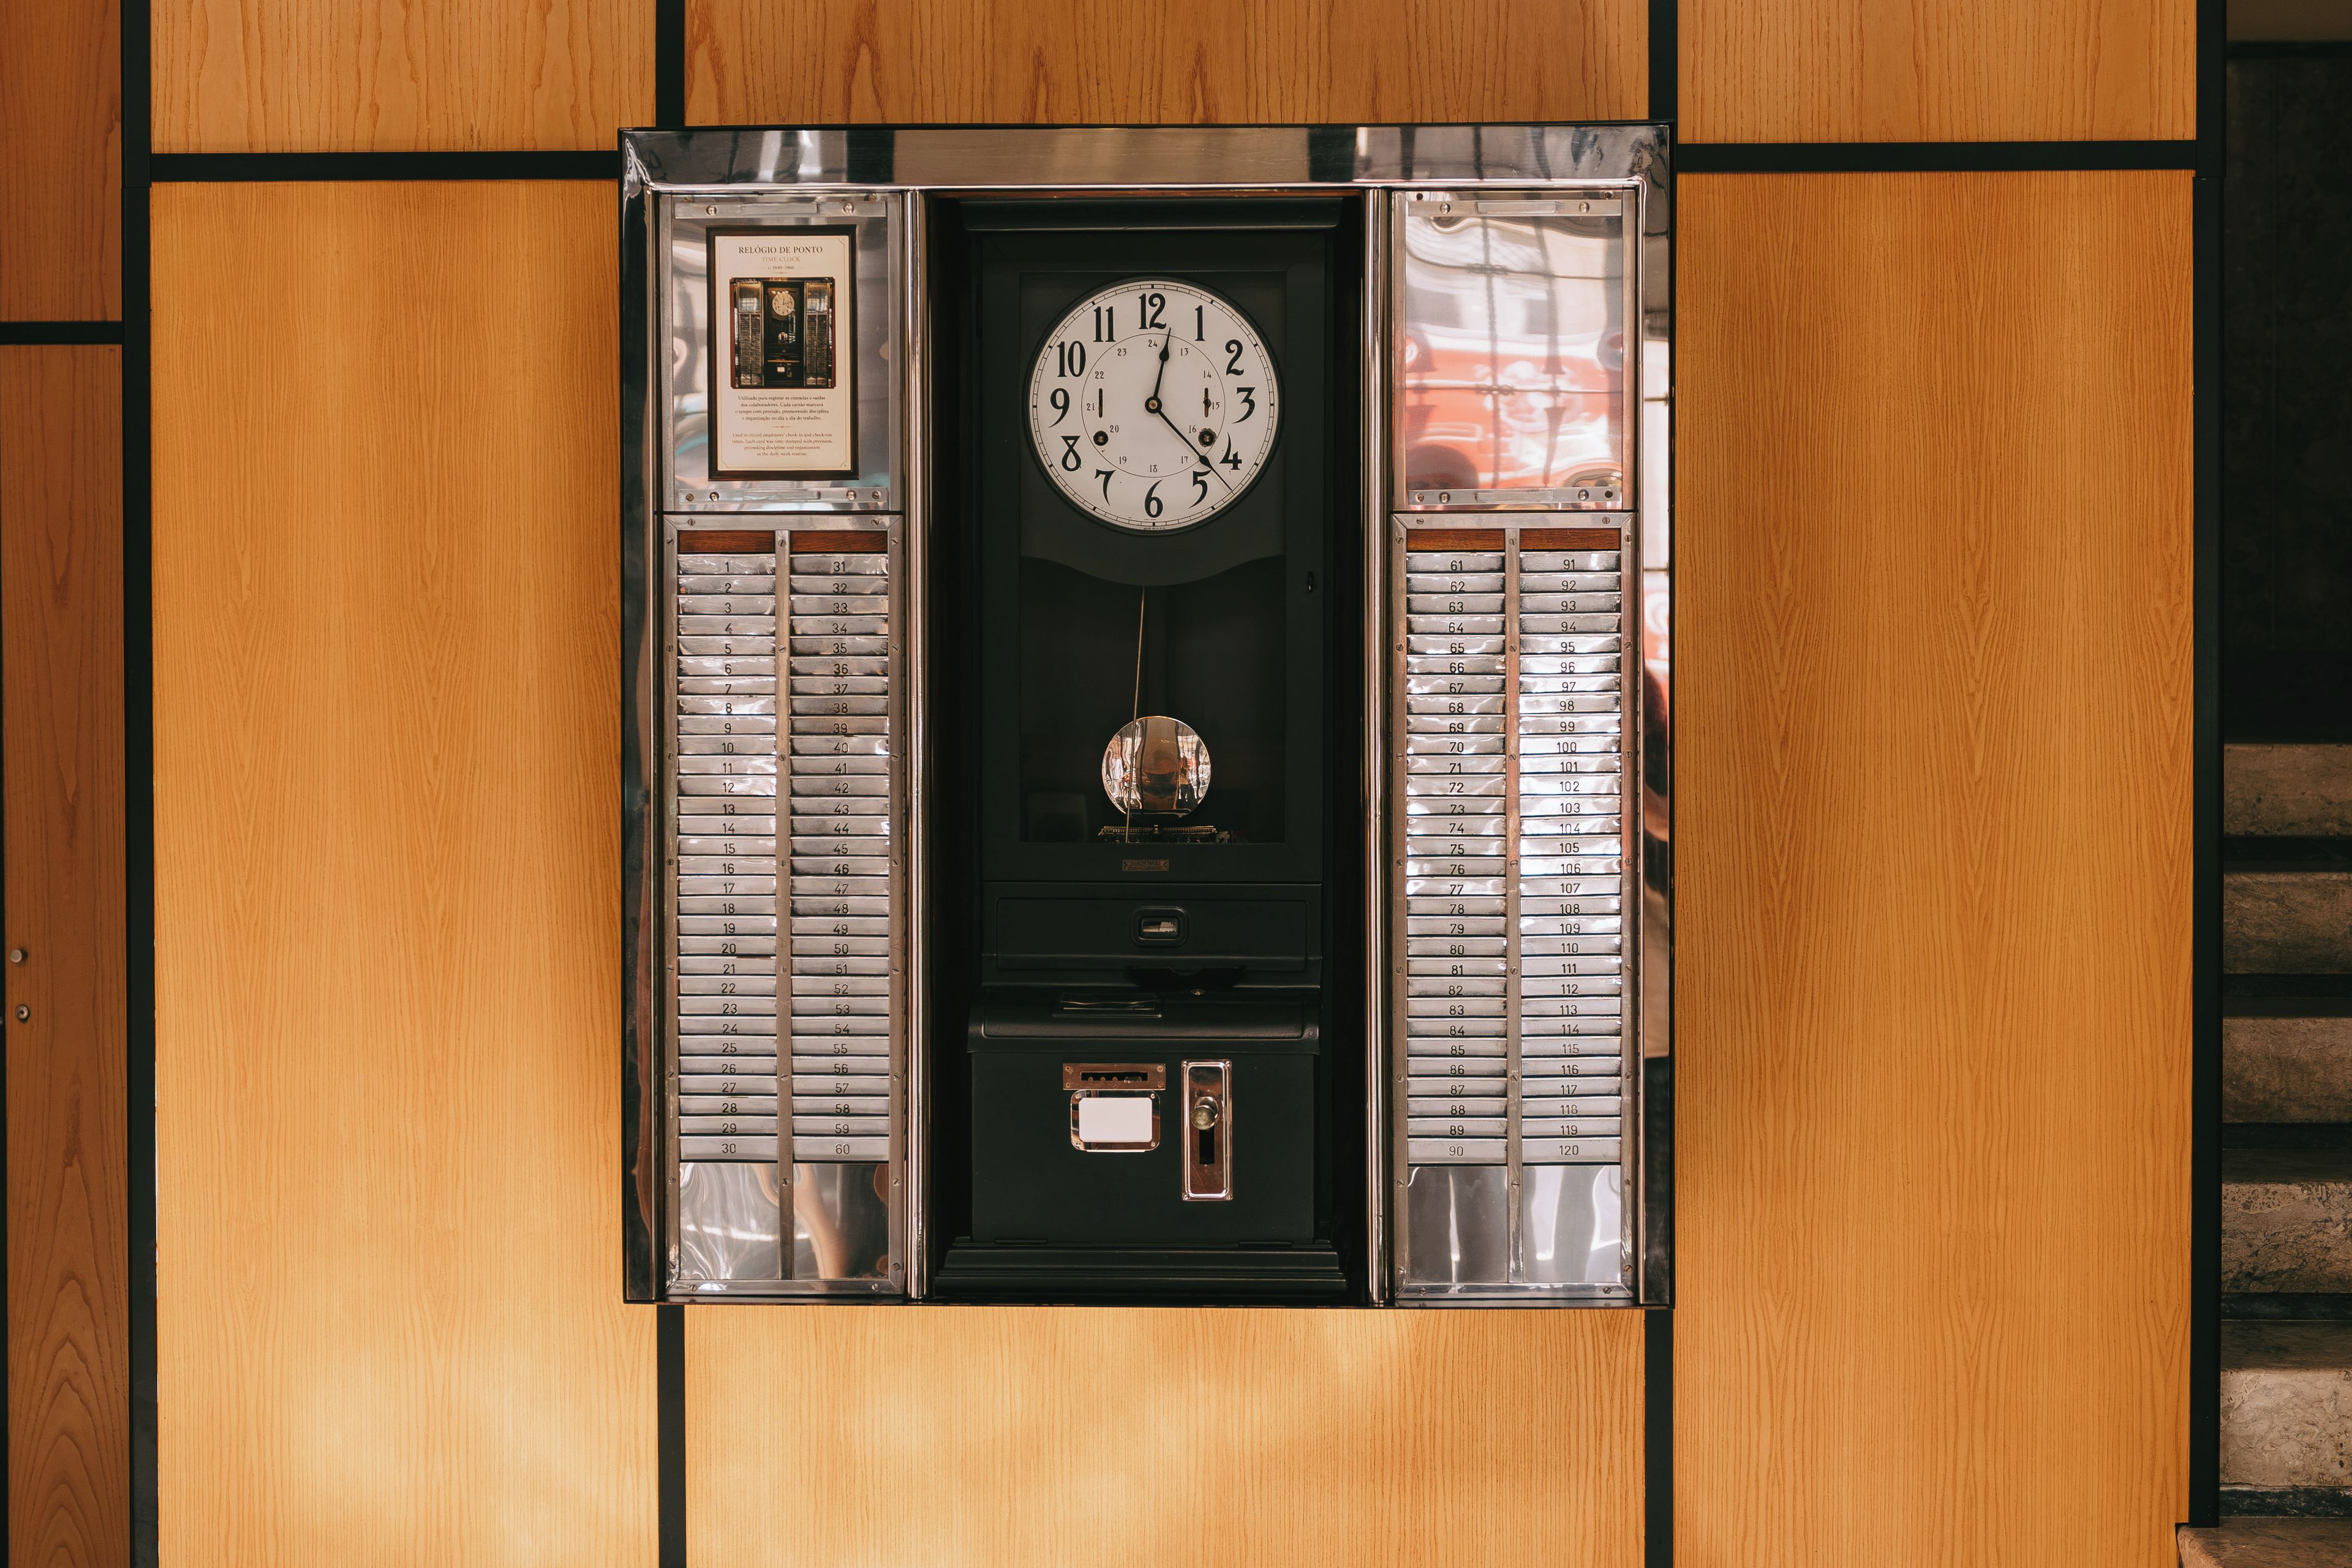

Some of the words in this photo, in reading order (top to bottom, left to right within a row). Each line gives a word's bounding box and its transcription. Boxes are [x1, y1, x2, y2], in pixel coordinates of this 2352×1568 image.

[739, 245, 777, 254] RELÓGIO
[1139, 293, 1166, 330] 12
[1093, 306, 1116, 342] 11
[1195, 305, 1205, 341] 1
[1057, 341, 1086, 377] 10
[1225, 339, 1244, 375] 2
[1048, 388, 1069, 428] 9
[1232, 387, 1256, 424] 3
[1060, 435, 1081, 471] 8
[1219, 432, 1242, 470] 4
[1095, 469, 1116, 506] 7
[1188, 470, 1212, 509] 5
[1145, 479, 1163, 518] 6
[725, 562, 729, 573] 1
[833, 561, 845, 572] 31
[1450, 560, 1463, 571] 61
[1563, 559, 1575, 570] 91
[725, 583, 732, 594] 2
[832, 583, 847, 594] 32
[1450, 581, 1465, 592] 62
[1561, 580, 1577, 591] 92
[725, 603, 731, 614] 3
[833, 603, 848, 614] 33
[1449, 601, 1464, 612] 63
[1561, 600, 1577, 611] 93
[725, 643, 732, 654] 5
[832, 643, 847, 654] 35
[1450, 642, 1465, 653] 65
[1561, 642, 1575, 653] 95
[725, 663, 732, 674] 6
[834, 663, 848, 674] 36
[1449, 662, 1464, 673] 66
[1560, 662, 1575, 673] 96
[725, 703, 733, 714] 8
[834, 703, 848, 714] 38
[1449, 702, 1464, 713] 68
[1559, 700, 1575, 711] 98
[724, 723, 731, 734] 9
[833, 723, 848, 734] 39
[1449, 722, 1464, 733] 69
[1559, 721, 1575, 732] 99
[722, 742, 734, 753] 10
[834, 742, 848, 753] 40
[1450, 741, 1464, 752] 70
[1557, 741, 1577, 752] 100
[722, 782, 734, 793] 12
[834, 783, 849, 794] 42
[1450, 782, 1464, 793] 72
[1559, 781, 1580, 792] 102
[723, 843, 736, 854] 15
[834, 843, 848, 854] 45
[1450, 844, 1464, 855] 75
[1559, 842, 1580, 853] 105
[722, 863, 734, 874] 16
[834, 863, 850, 874] 46
[1450, 864, 1465, 875] 76
[1561, 863, 1581, 874] 106
[722, 903, 735, 914] 18
[834, 903, 849, 914] 48
[1450, 903, 1464, 914] 78
[1560, 903, 1580, 914] 108
[723, 922, 736, 933] 19
[833, 924, 848, 935] 49
[1450, 923, 1464, 934] 79
[1560, 923, 1580, 934] 109
[722, 943, 736, 954] 20
[834, 943, 849, 954] 50
[1450, 944, 1464, 956] 80
[1561, 943, 1578, 954] 110
[723, 964, 736, 975] 21
[835, 964, 848, 975] 51
[1451, 964, 1463, 975] 81
[1561, 963, 1577, 974] 111
[721, 983, 736, 994] 22
[834, 984, 848, 995] 52
[1448, 985, 1463, 996] 82
[1561, 984, 1578, 995] 112
[723, 1003, 737, 1014] 23
[835, 1004, 850, 1015] 53
[1449, 1005, 1464, 1016] 83
[1560, 1005, 1578, 1016] 113
[722, 1042, 737, 1054] 25
[834, 1043, 848, 1054] 55
[1450, 1045, 1465, 1056] 85
[1562, 1044, 1580, 1055] 115
[722, 1063, 736, 1074] 26
[834, 1063, 848, 1074] 56
[1450, 1064, 1465, 1075] 86
[1561, 1064, 1579, 1075] 116
[722, 1082, 736, 1093] 27
[835, 1082, 849, 1093] 57
[1450, 1084, 1465, 1095] 87
[1561, 1084, 1577, 1095] 117
[722, 1102, 737, 1114] 28
[835, 1103, 850, 1114] 58
[1450, 1104, 1466, 1115] 88
[1560, 1104, 1578, 1115] 118
[722, 1123, 737, 1134] 29
[835, 1123, 850, 1134] 59
[1449, 1125, 1464, 1136] 89
[1561, 1125, 1578, 1136] 119
[722, 1143, 736, 1154] 30
[835, 1144, 850, 1155] 60
[1449, 1145, 1464, 1156] 90
[1559, 1145, 1579, 1156] 120
